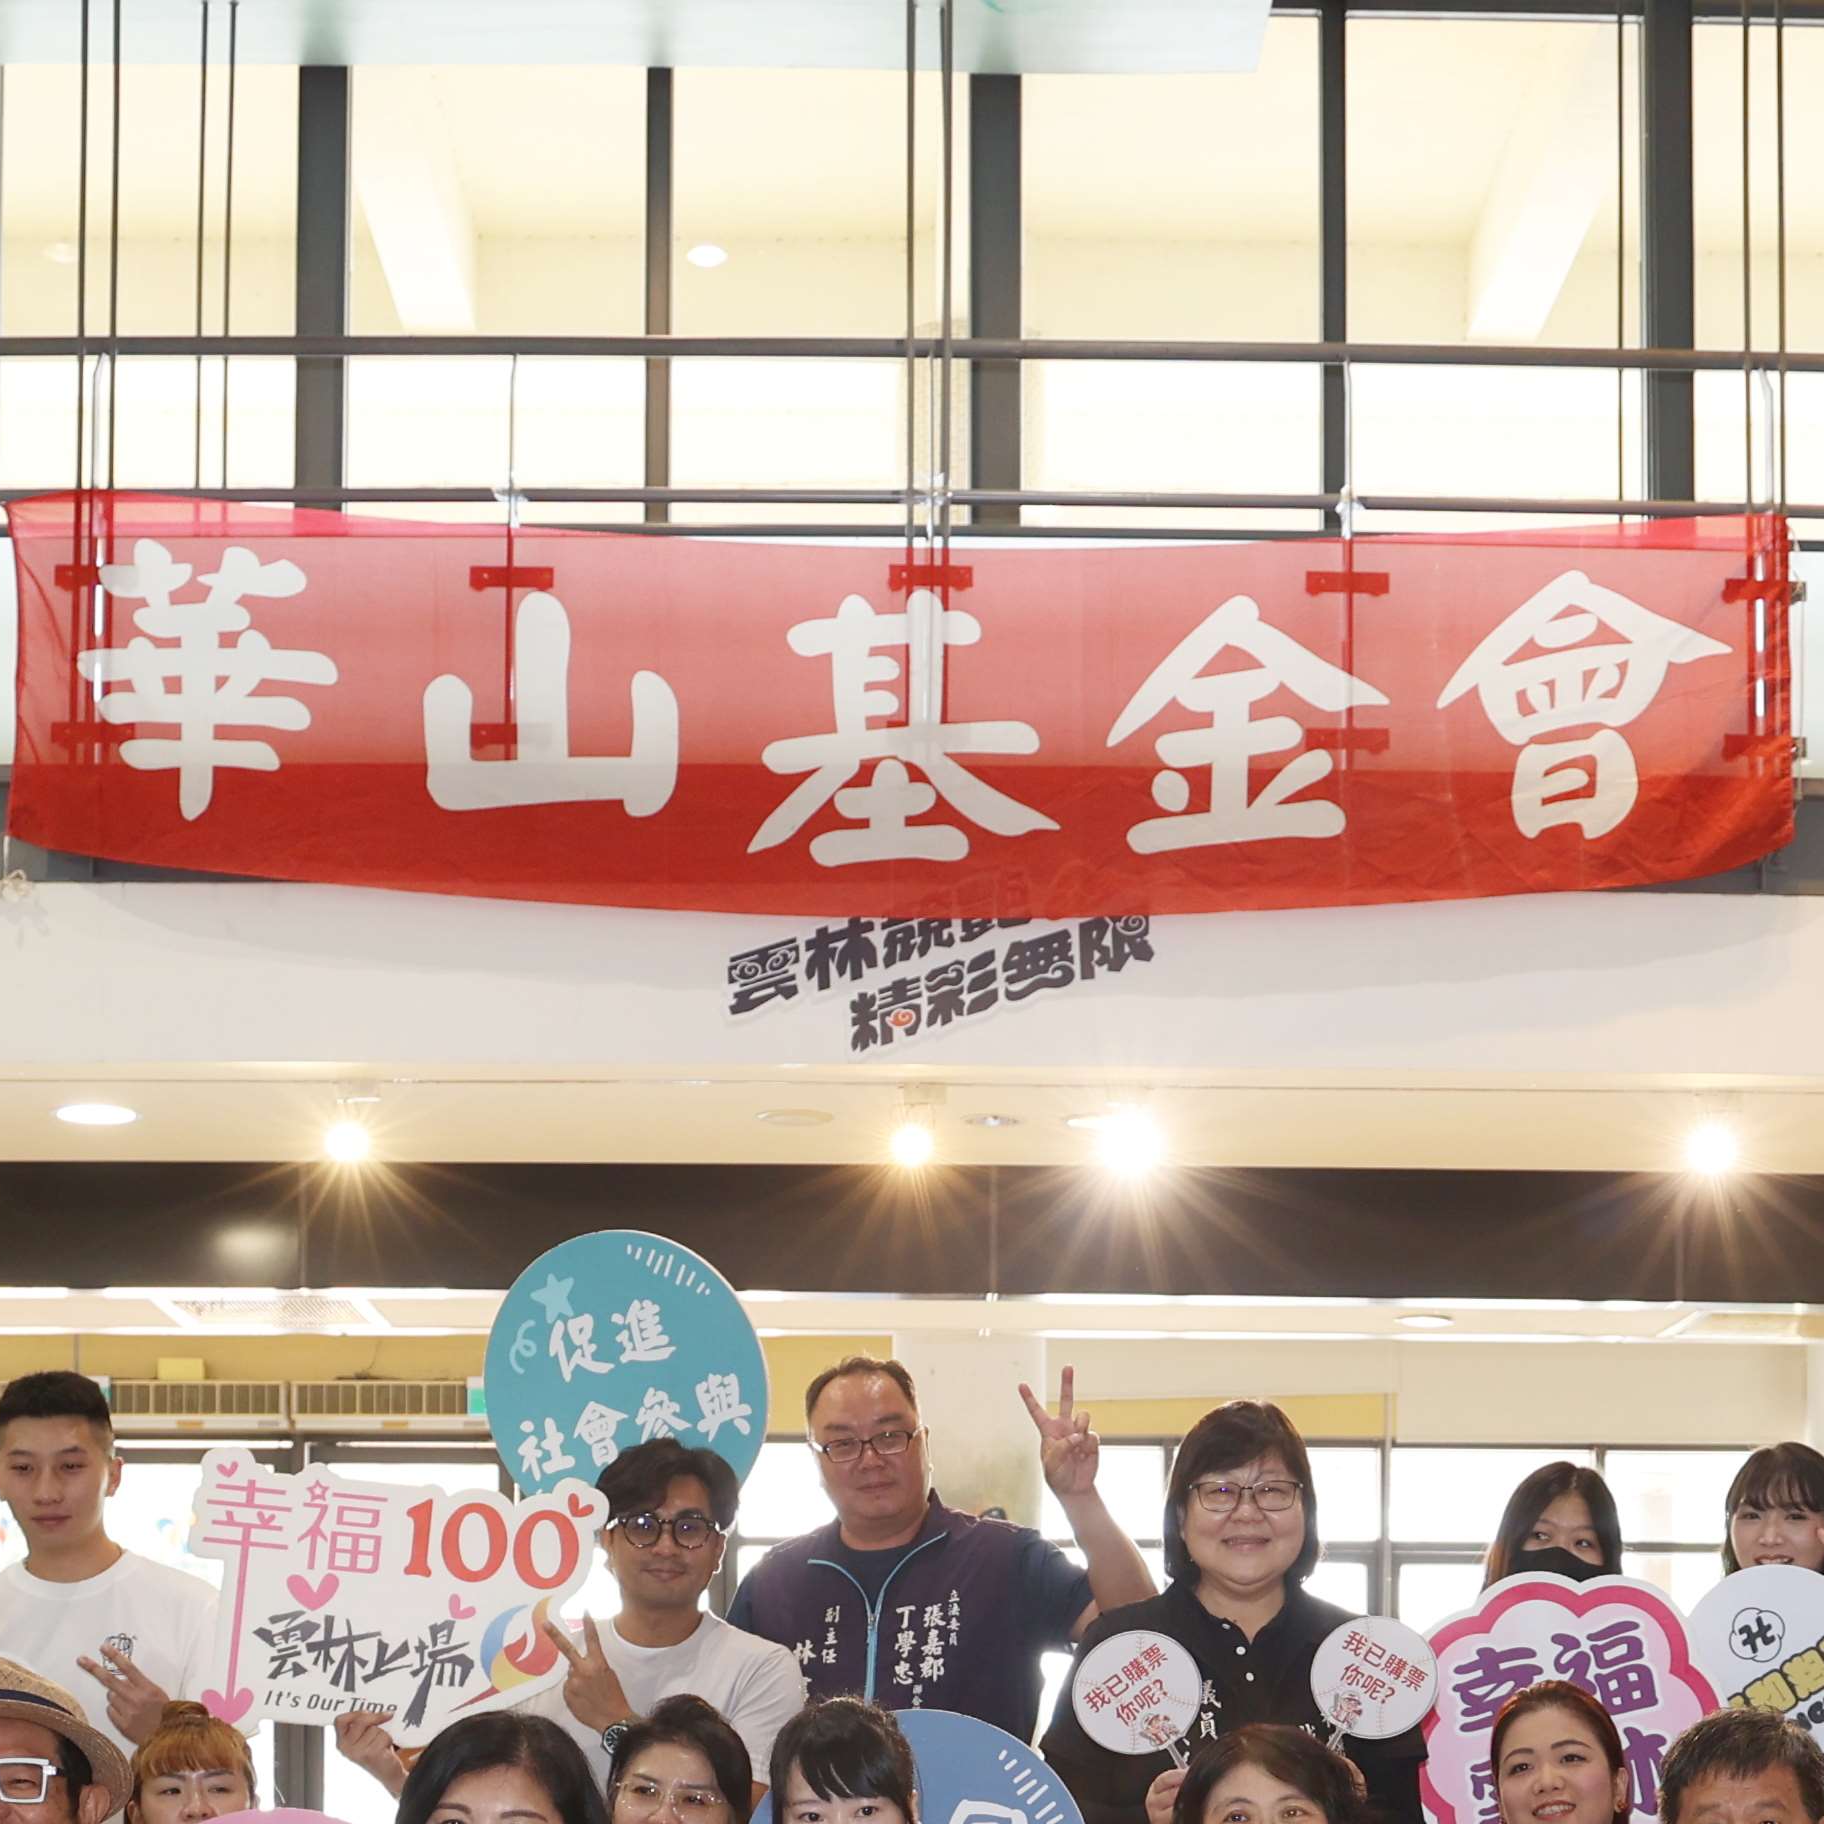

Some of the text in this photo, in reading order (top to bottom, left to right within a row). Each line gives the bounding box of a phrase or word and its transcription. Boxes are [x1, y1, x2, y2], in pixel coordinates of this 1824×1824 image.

[76, 537, 1732, 866] 華山基金會
[850, 914, 1154, 1052] 精彩無限
[548, 1299, 677, 1384] 促進
[519, 1372, 755, 1476] 社會參與
[252, 1610, 474, 1731] 雲林上場
[821, 1605, 841, 1665] 副主任
[893, 1604, 917, 1685] 丁學忠
[920, 1603, 947, 1682] 張嘉郡
[1341, 1630, 1430, 1694] 我已購票
[1452, 1620, 1658, 1733] 幸福
[264, 1689, 300, 1709] It's
[307, 1694, 344, 1712] Our
[1083, 1643, 1170, 1714] 我已購票
